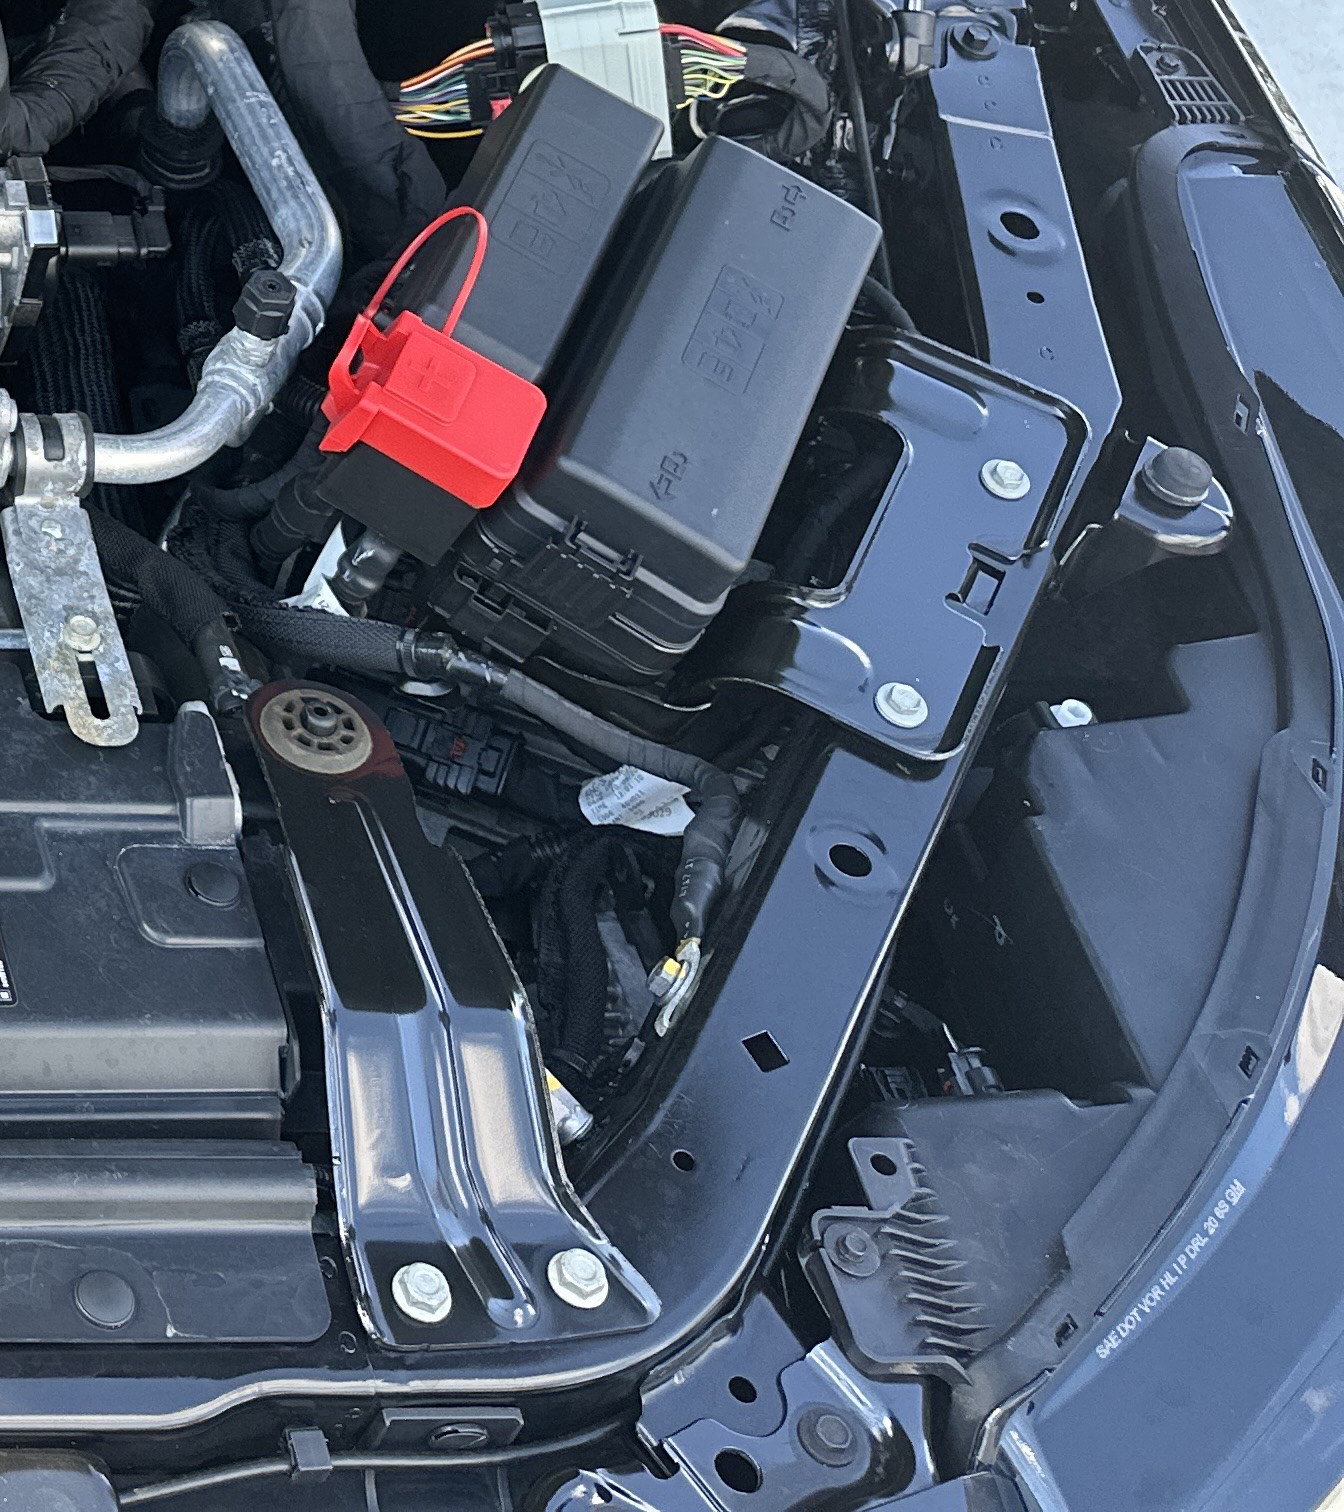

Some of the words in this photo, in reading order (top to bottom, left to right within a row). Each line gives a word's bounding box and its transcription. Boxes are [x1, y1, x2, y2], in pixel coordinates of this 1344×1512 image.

[1095, 1329, 1122, 1359] SAE
[1116, 1307, 1142, 1338] DOT
[1138, 1285, 1165, 1313] VOR
[1159, 1270, 1178, 1290] HL
[1177, 1254, 1188, 1269] P
[1185, 1233, 1209, 1259] DRL
[1203, 1215, 1219, 1235] 20
